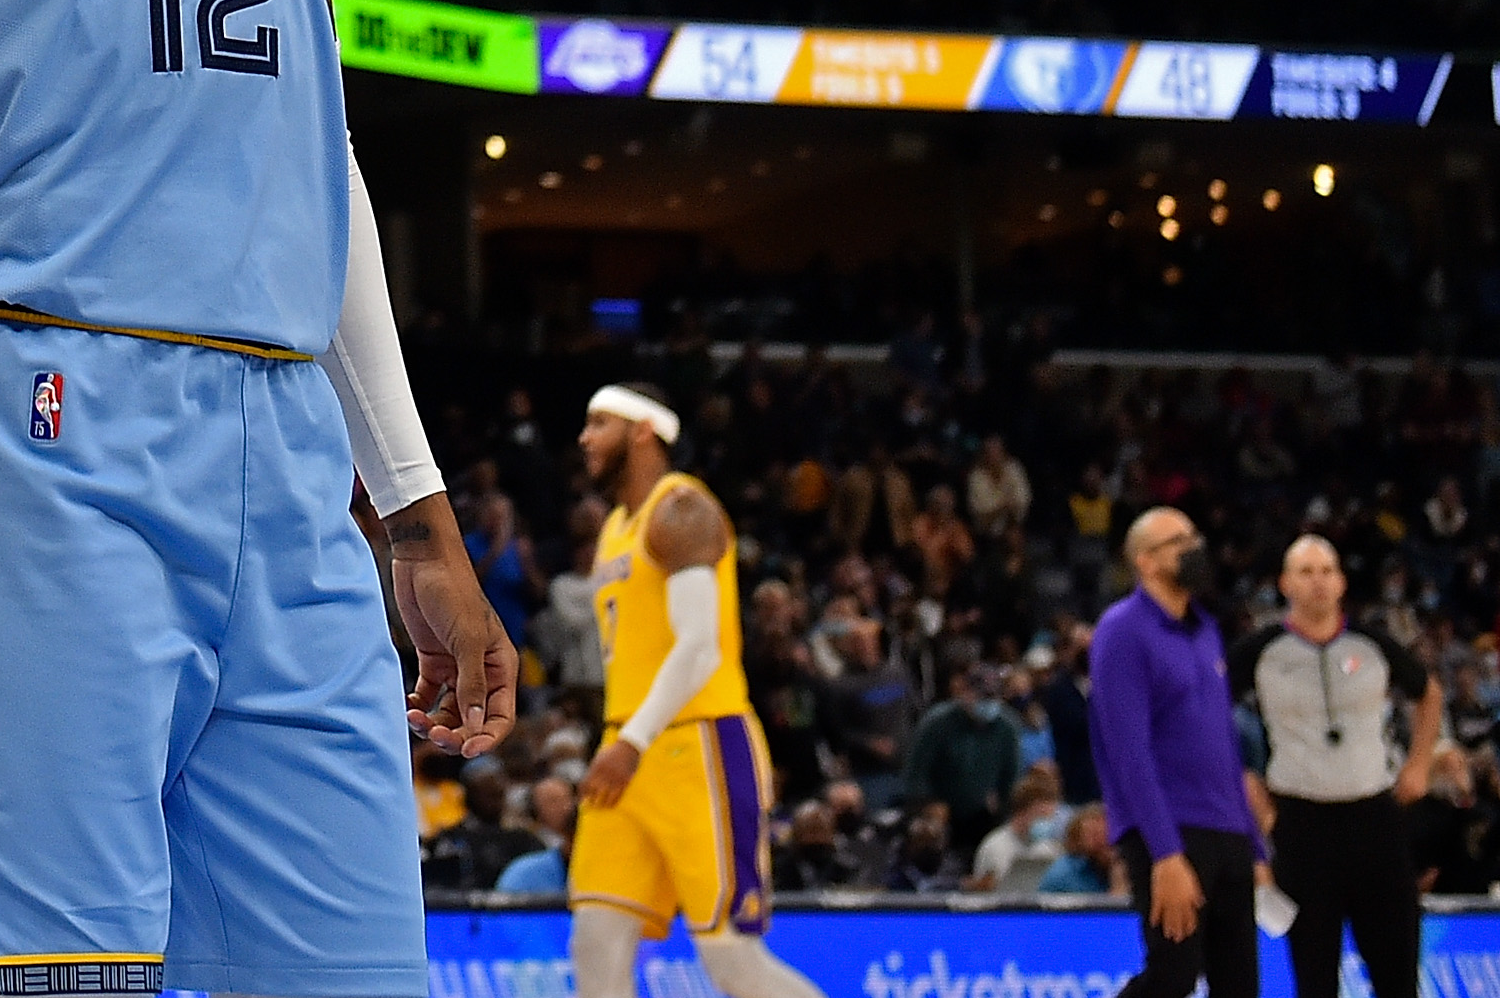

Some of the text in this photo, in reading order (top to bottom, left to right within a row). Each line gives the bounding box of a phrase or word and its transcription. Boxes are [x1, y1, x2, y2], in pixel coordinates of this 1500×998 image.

[702, 29, 757, 98] 54
[1159, 45, 1211, 117] 48
[34, 421, 45, 436] 75
